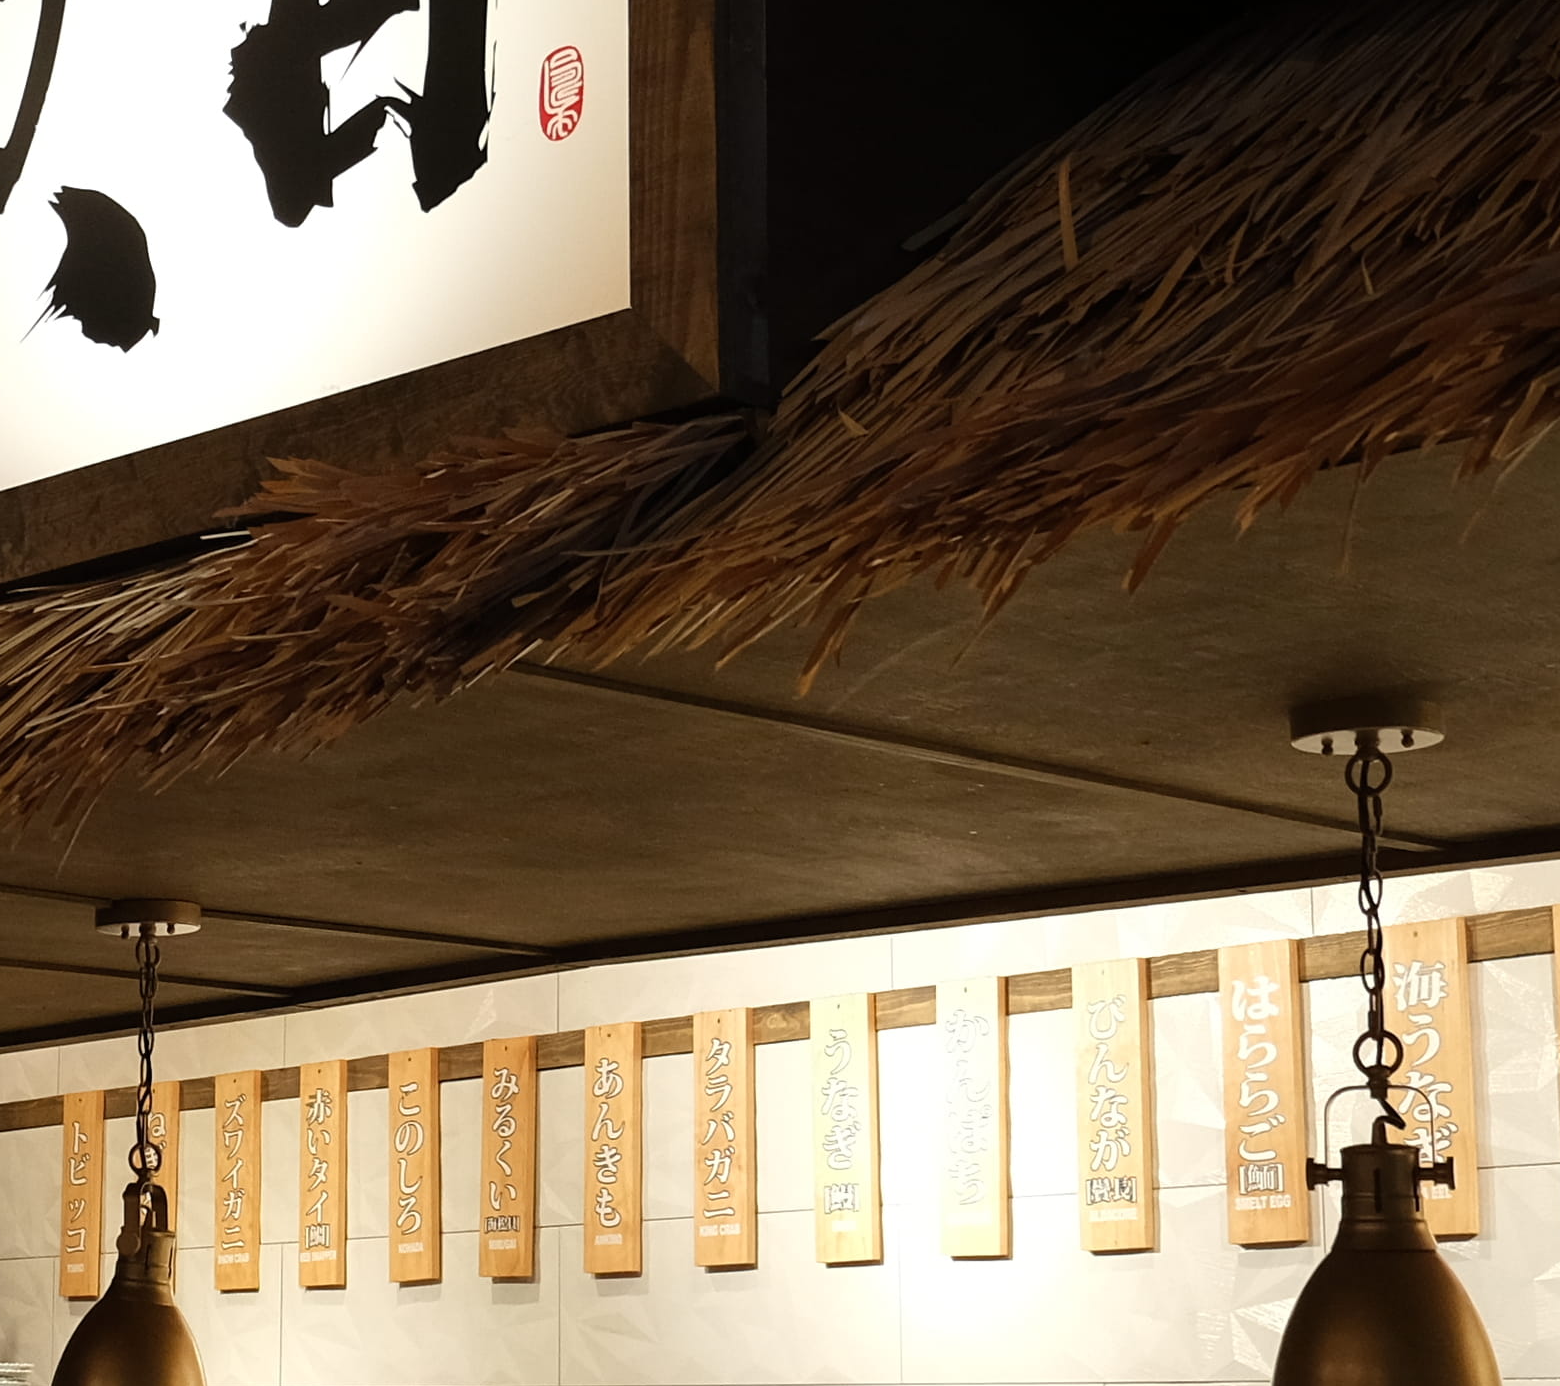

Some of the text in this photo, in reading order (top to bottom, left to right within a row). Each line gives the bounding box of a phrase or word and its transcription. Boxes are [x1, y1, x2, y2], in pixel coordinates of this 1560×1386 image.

[491, 1068, 520, 1211] みるくい
[592, 1057, 625, 1228] あんきも
[702, 1038, 736, 1219] タラバガニ
[821, 1028, 861, 1170] うなぎ
[1087, 994, 1131, 1171] びんなが
[1231, 976, 1286, 1160] はららご
[65, 1120, 91, 1254] トビッコ
[221, 1093, 247, 1250] ズワイガニ
[306, 1088, 333, 1223] 赤いタイ
[393, 1081, 424, 1235] このしろ
